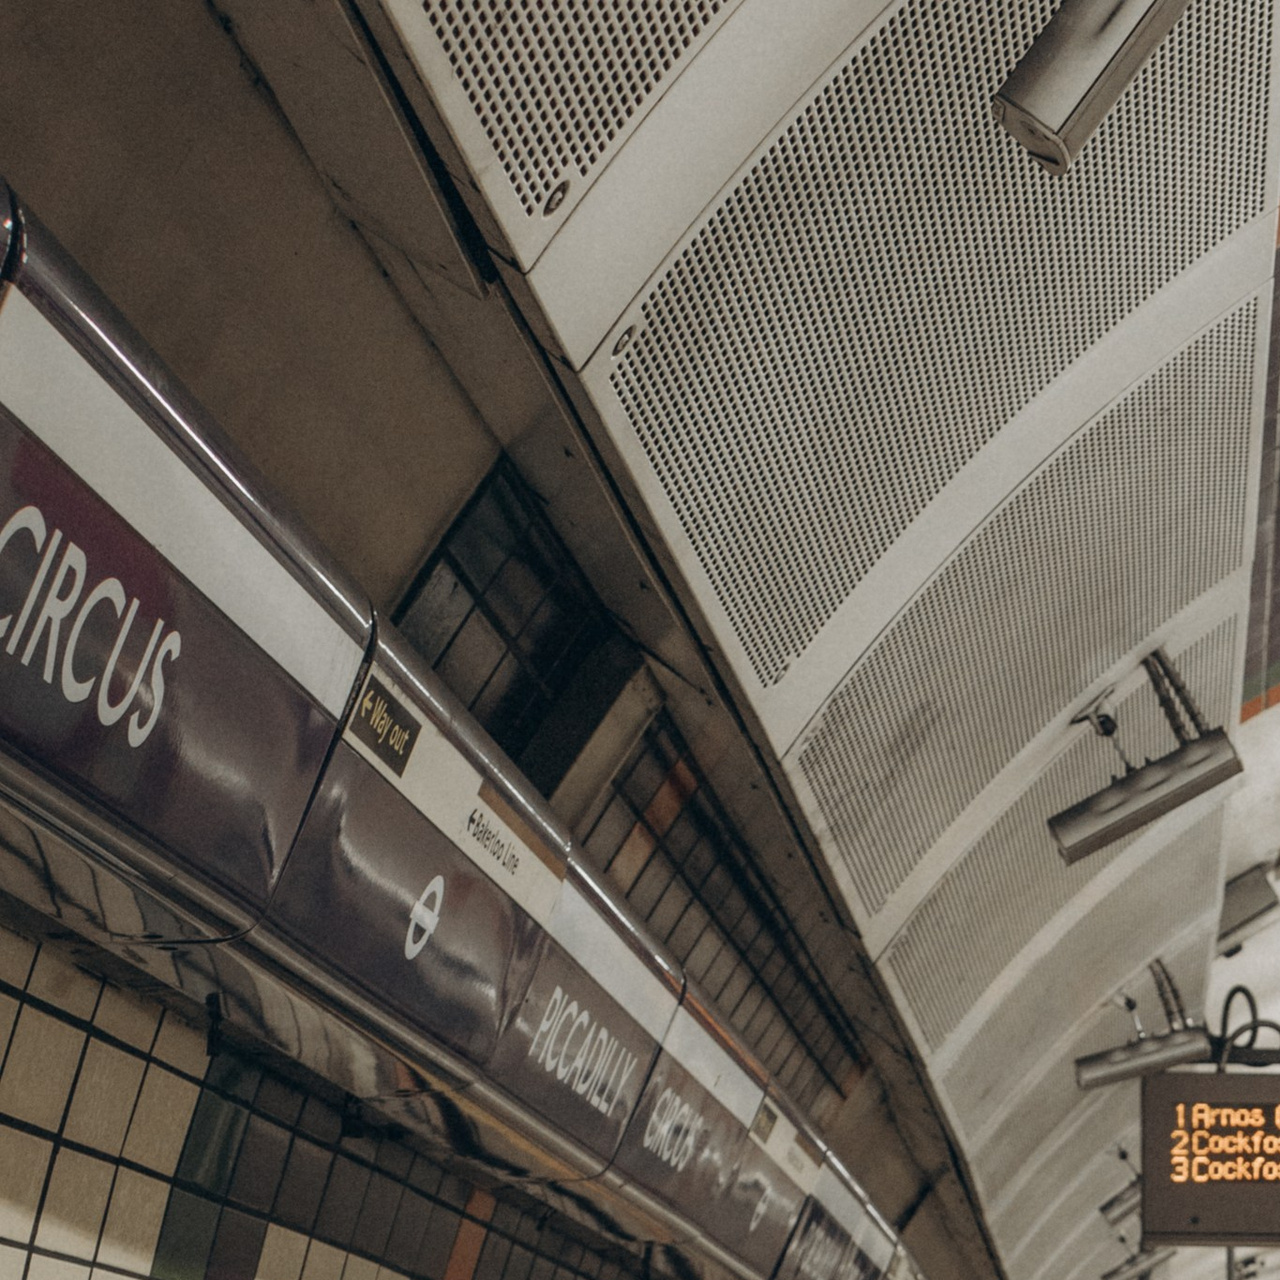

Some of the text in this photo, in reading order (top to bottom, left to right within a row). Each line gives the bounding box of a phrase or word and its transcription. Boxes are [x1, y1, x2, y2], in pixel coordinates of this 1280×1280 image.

[0, 505, 182, 749] CIRCUS
[370, 695, 411, 756] Way out
[471, 811, 521, 877] Bakerloo Line
[528, 984, 639, 1118] PICCADILLY
[643, 1086, 705, 1174] CIRCUS
[1170, 1129, 1190, 1156] 2
[1175, 1102, 1186, 1128] 1
[1191, 1102, 1266, 1129] Arnos
[1170, 1156, 1190, 1183] 3
